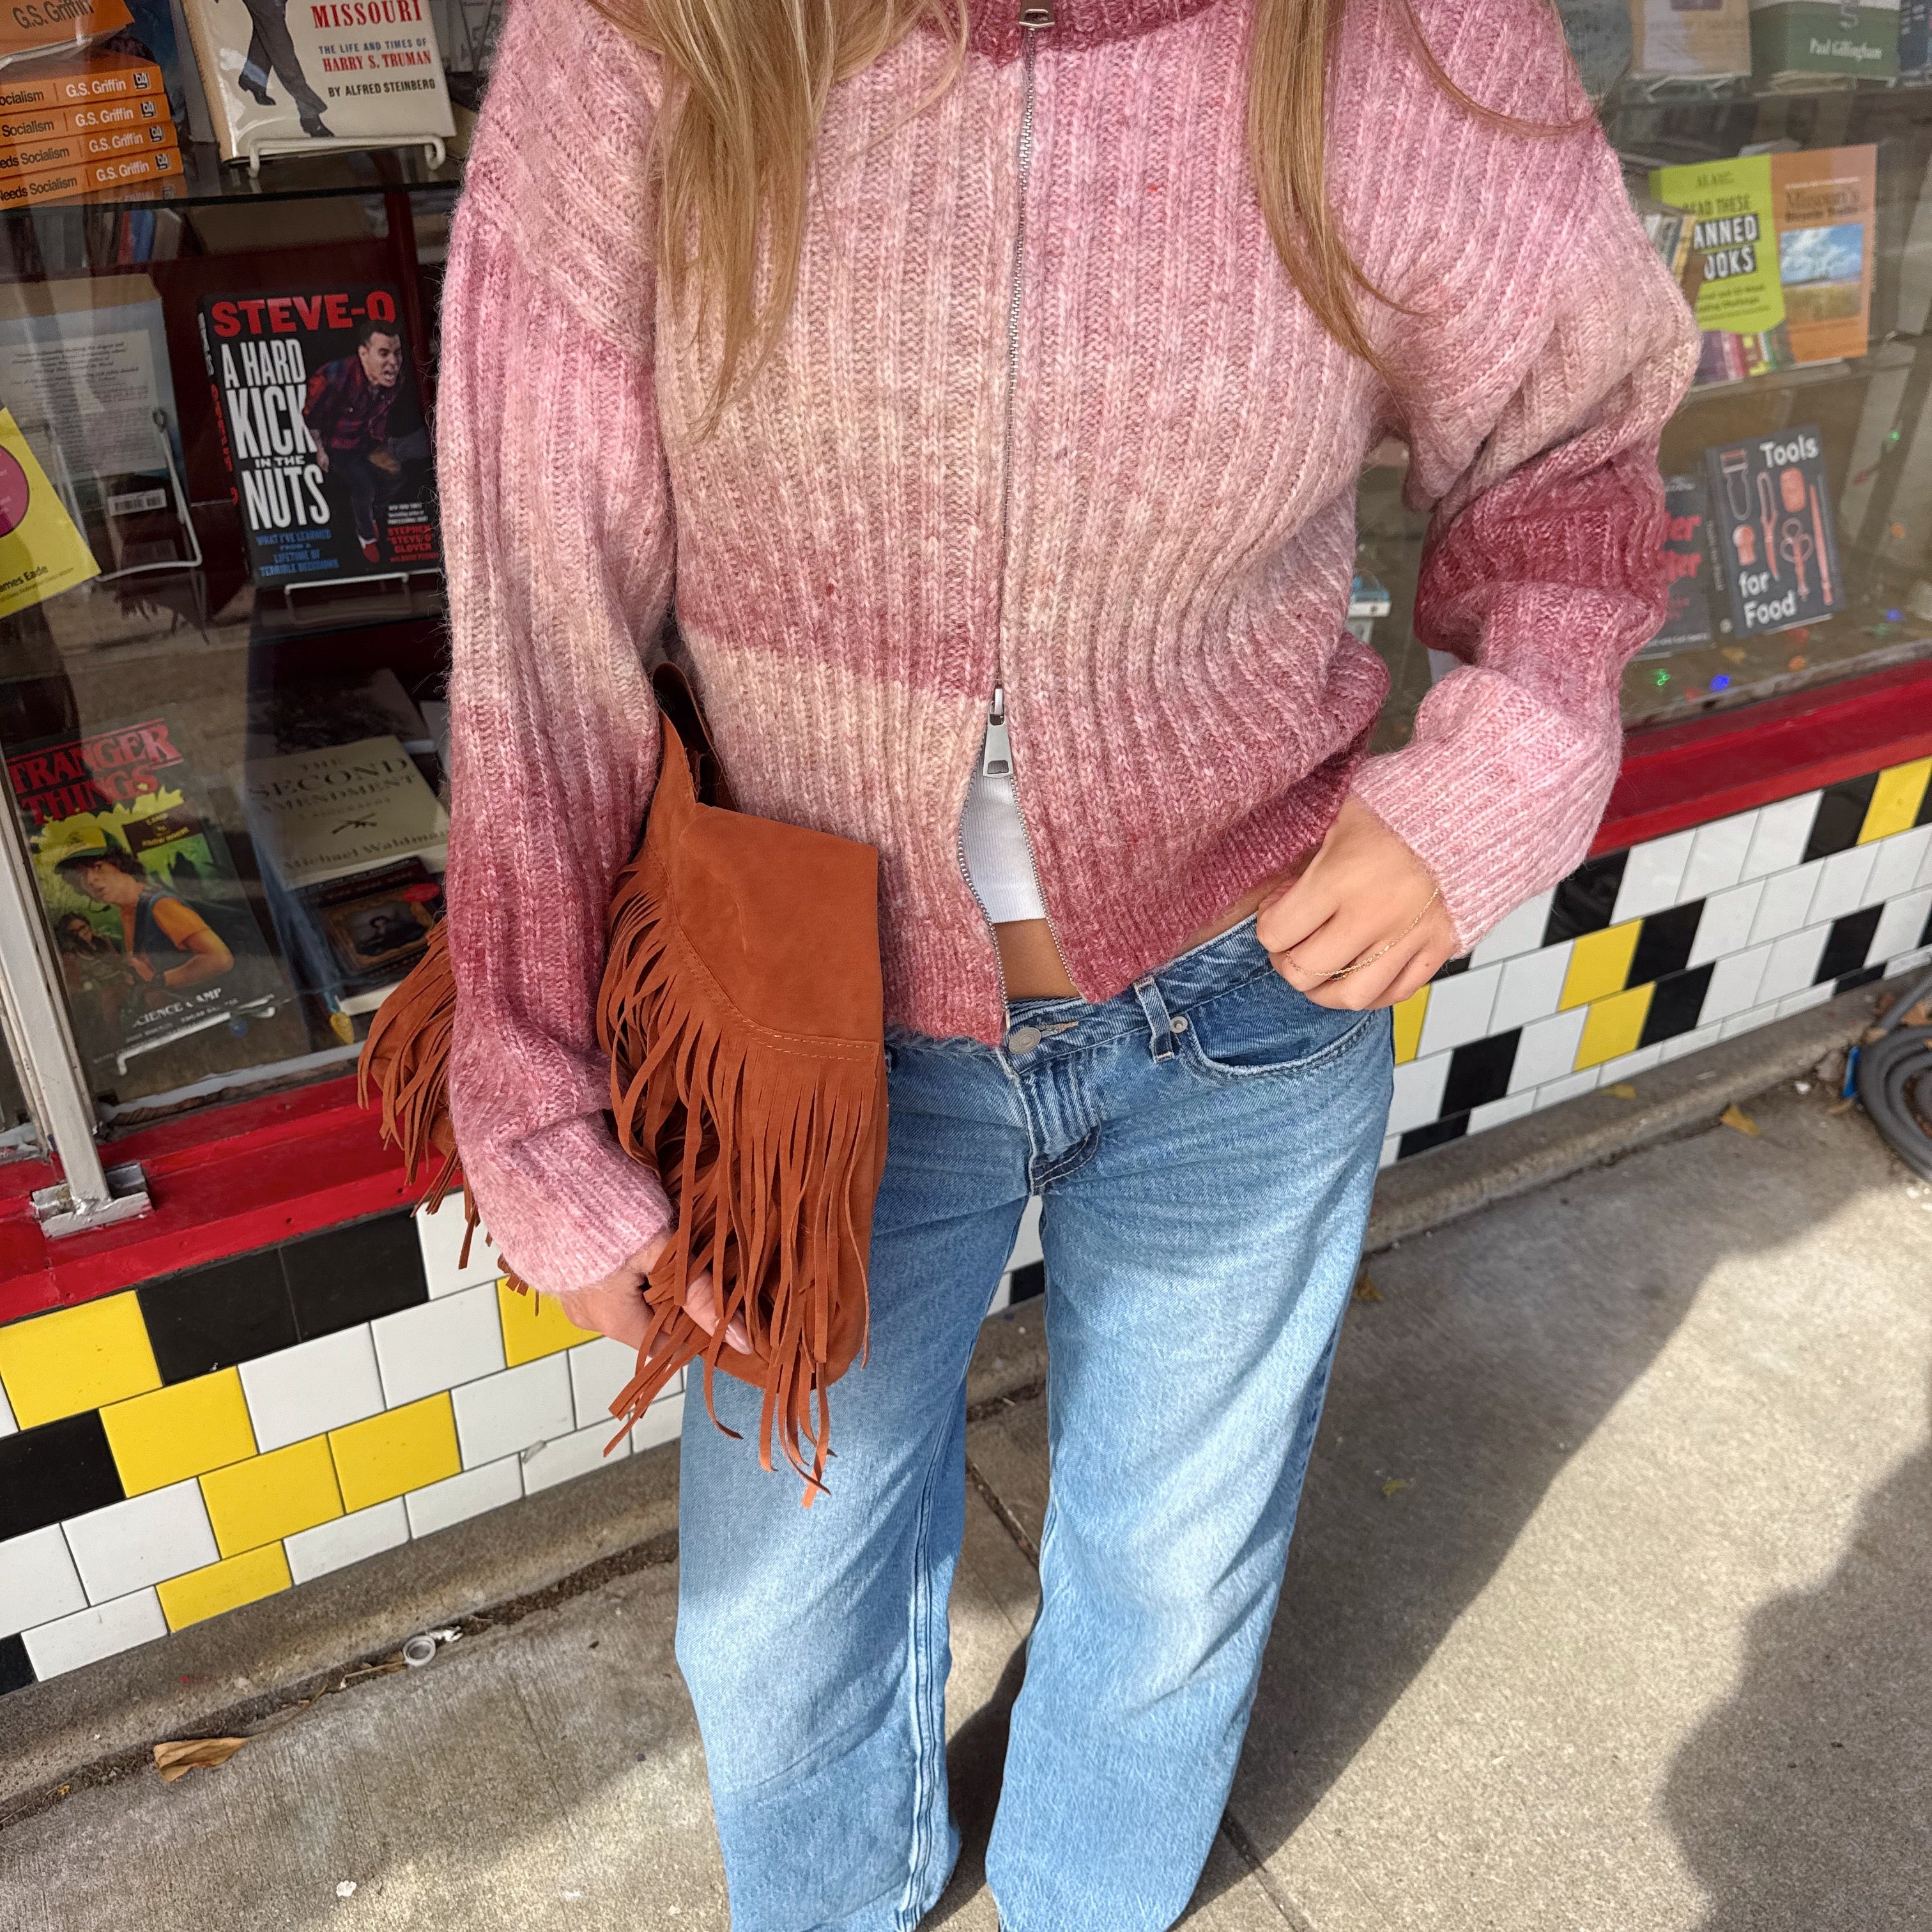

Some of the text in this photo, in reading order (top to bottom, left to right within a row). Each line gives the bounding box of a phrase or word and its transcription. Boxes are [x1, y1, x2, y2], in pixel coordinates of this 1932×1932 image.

[12, 4, 48, 29] G.S.
[310, 0, 423, 29] MISSOURI
[319, 38, 427, 55] THE LIFE AND TIMES OF
[323, 50, 431, 72] HARRY S. TRUMAN
[66, 84, 90, 97] G.S.
[91, 79, 126, 95] Griffin
[328, 78, 436, 98] BY ALFRED STEINBERG
[2, 107, 134, 137] Socialism G.S. Griffin
[20, 148, 70, 164] Socialism
[89, 139, 110, 153] G.S.
[111, 132, 144, 148] Griffin
[29, 176, 77, 194] Socialism
[96, 167, 118, 182] G.S.
[118, 160, 150, 177] Griffin
[211, 290, 396, 337] STEVE-O
[220, 342, 240, 389] A
[240, 339, 307, 388] HARD
[226, 383, 319, 460] KICK
[255, 454, 305, 469] IN THE
[1759, 434, 1820, 468] Tools
[241, 464, 331, 531] NUTS
[24, 566, 49, 581] Eade
[1738, 571, 1770, 598] for
[1744, 589, 1797, 628] Food
[249, 756, 410, 798] SECOND
[20, 768, 159, 825] THINGS
